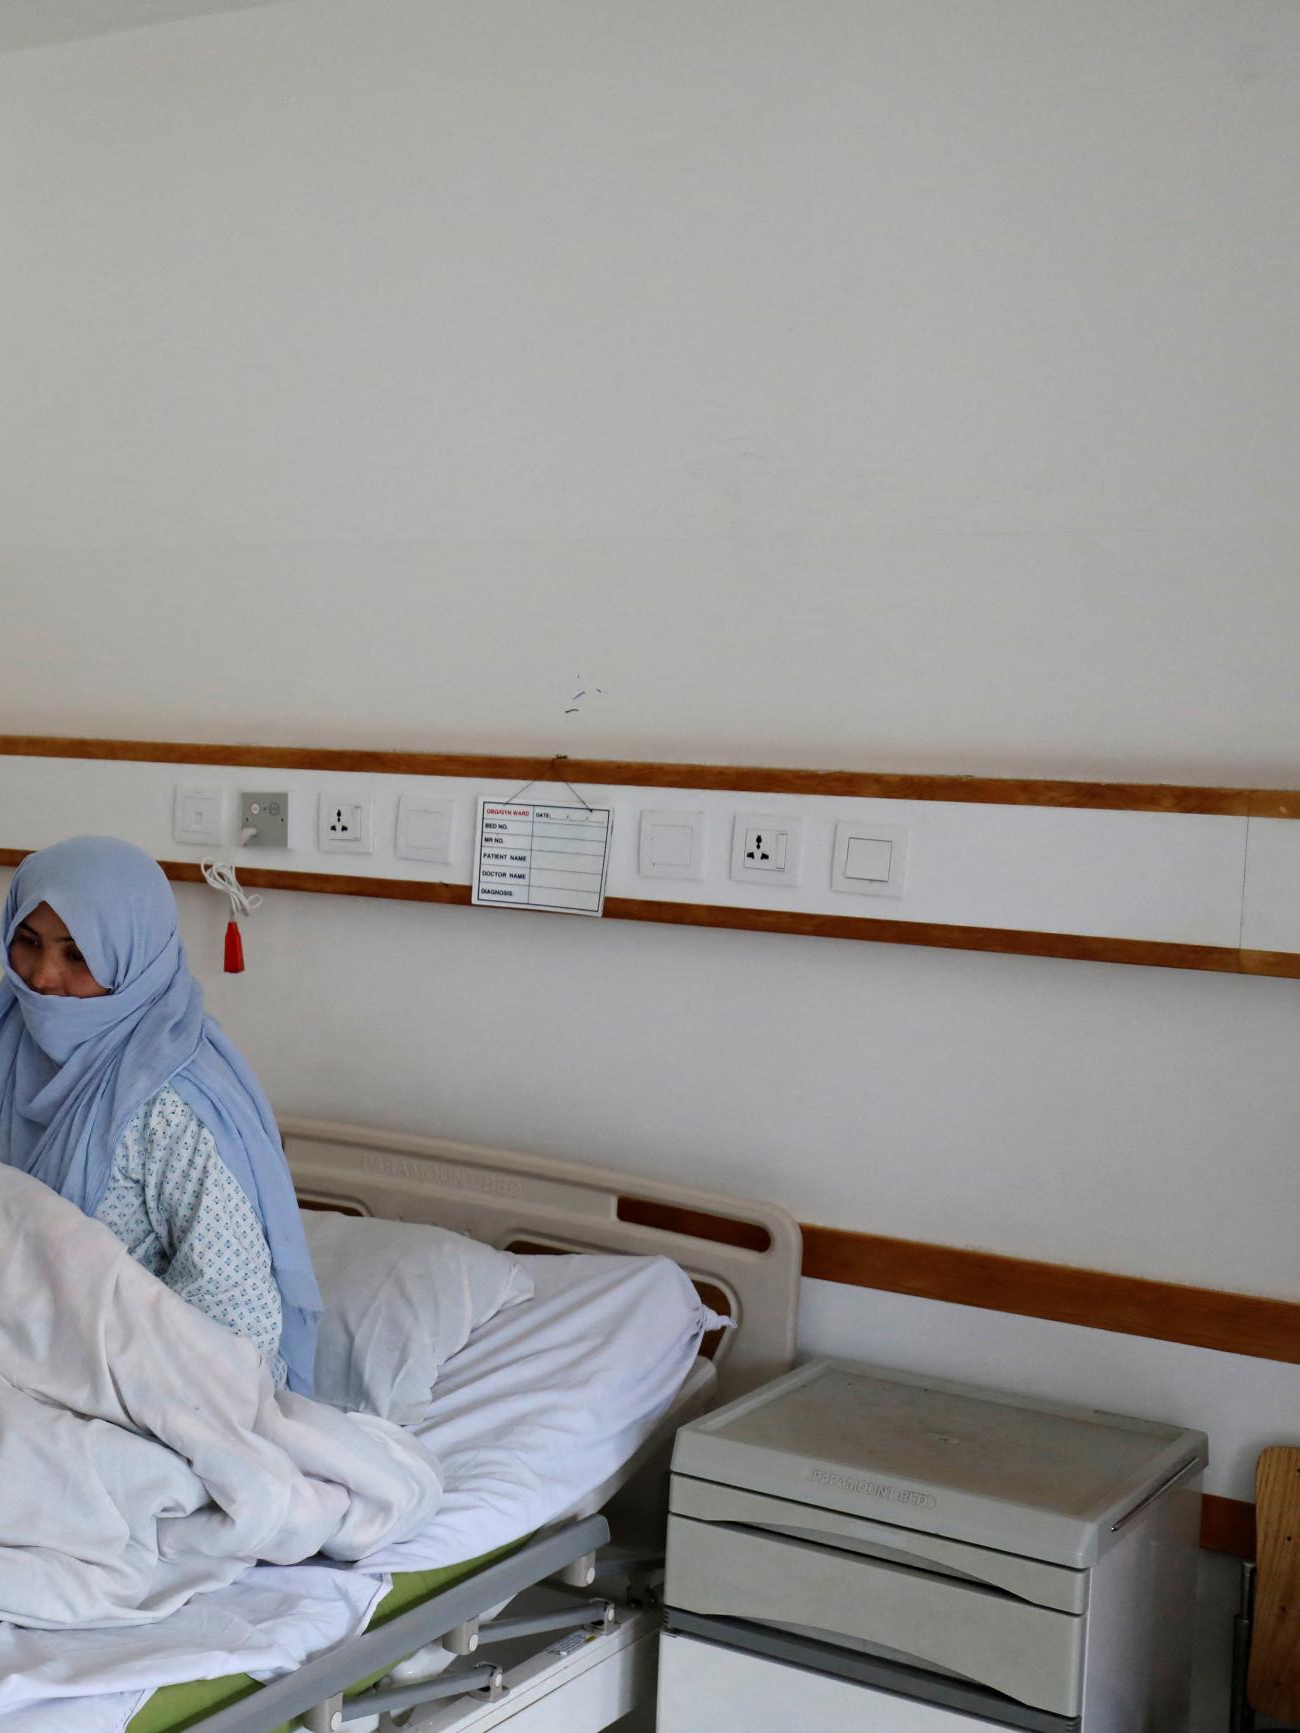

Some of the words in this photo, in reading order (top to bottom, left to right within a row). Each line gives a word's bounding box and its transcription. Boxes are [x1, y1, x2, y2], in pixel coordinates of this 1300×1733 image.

[482, 870, 507, 878] DOCTOR
[359, 1153, 475, 1189] PARAMOUNT
[483, 1177, 521, 1198] BED
[812, 1469, 893, 1498] PARAMOUNT
[898, 1489, 928, 1507] BED
